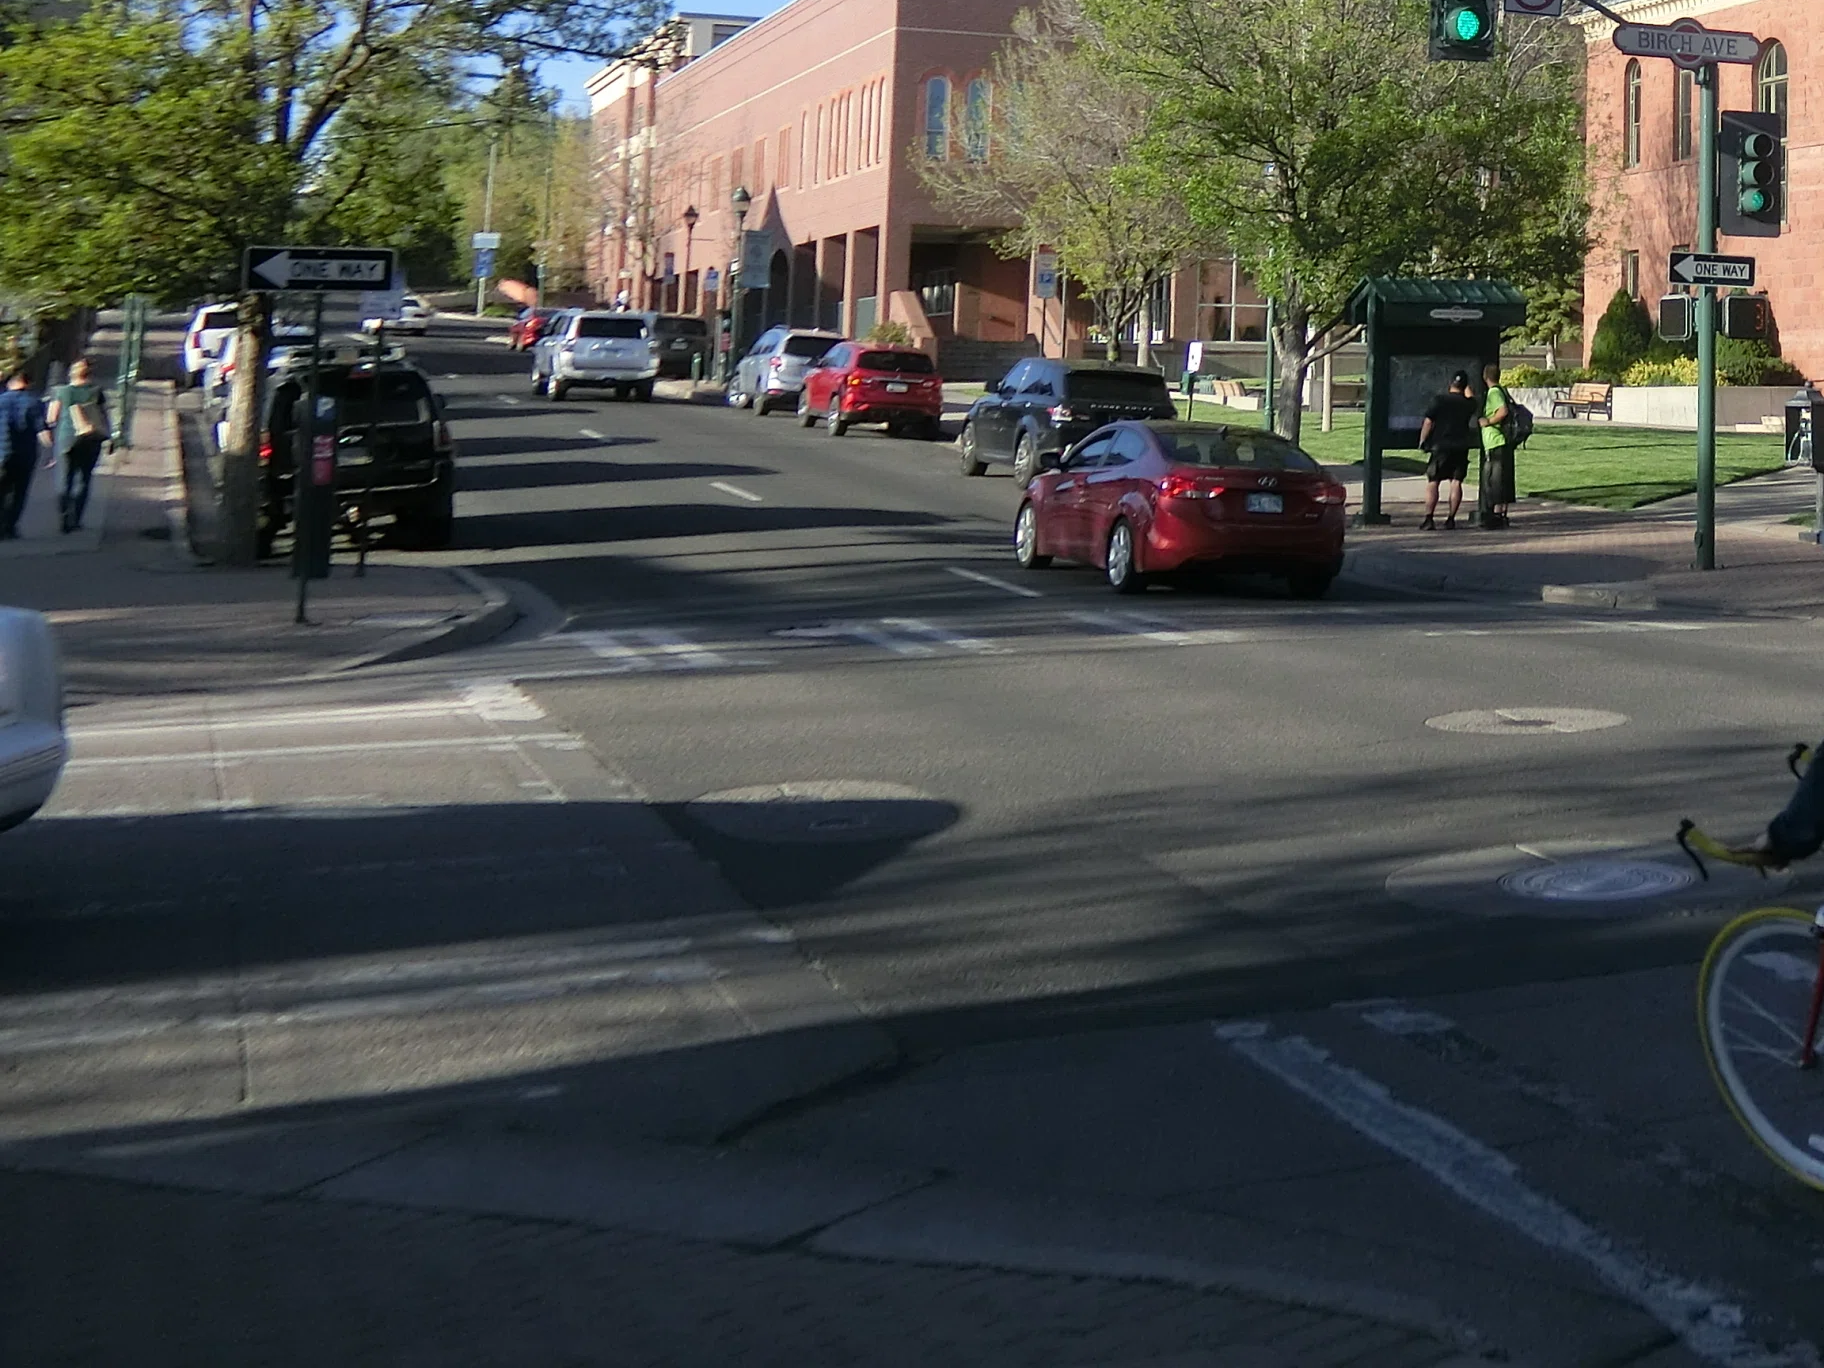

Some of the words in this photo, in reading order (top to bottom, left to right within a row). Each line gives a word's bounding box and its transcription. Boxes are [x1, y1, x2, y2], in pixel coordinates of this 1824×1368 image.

[1638, 31, 1692, 53] BIRCH
[1702, 36, 1738, 56] AVE
[291, 261, 331, 278] ONE
[339, 263, 378, 279] WAY
[1695, 263, 1719, 275] ONE
[1722, 264, 1746, 278] WAY
[316, 396, 335, 418] P
